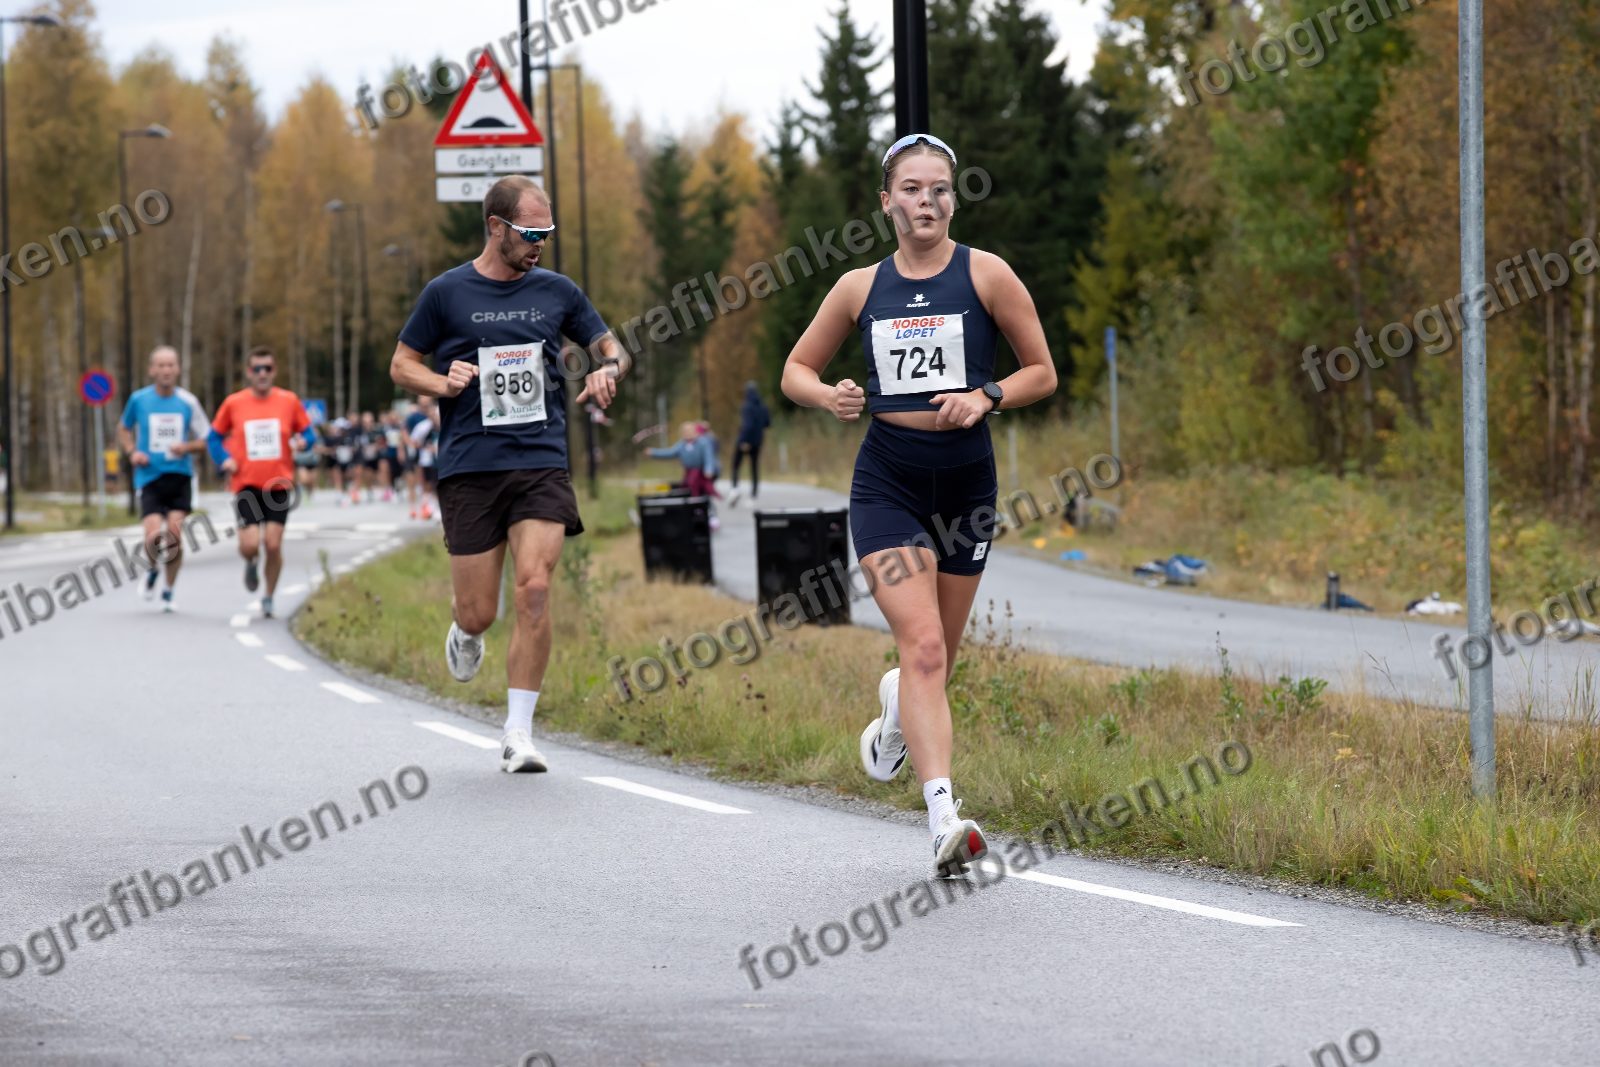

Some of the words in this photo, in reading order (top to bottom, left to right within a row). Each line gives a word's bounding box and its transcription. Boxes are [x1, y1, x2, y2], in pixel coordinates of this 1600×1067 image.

[471, 310, 529, 323] CRAFT
[892, 316, 945, 330] NORGES
[896, 327, 937, 340] LØPET
[495, 349, 533, 360] NORGES
[498, 357, 527, 367] LØPET
[889, 346, 947, 381] 724
[494, 370, 533, 396] 958
